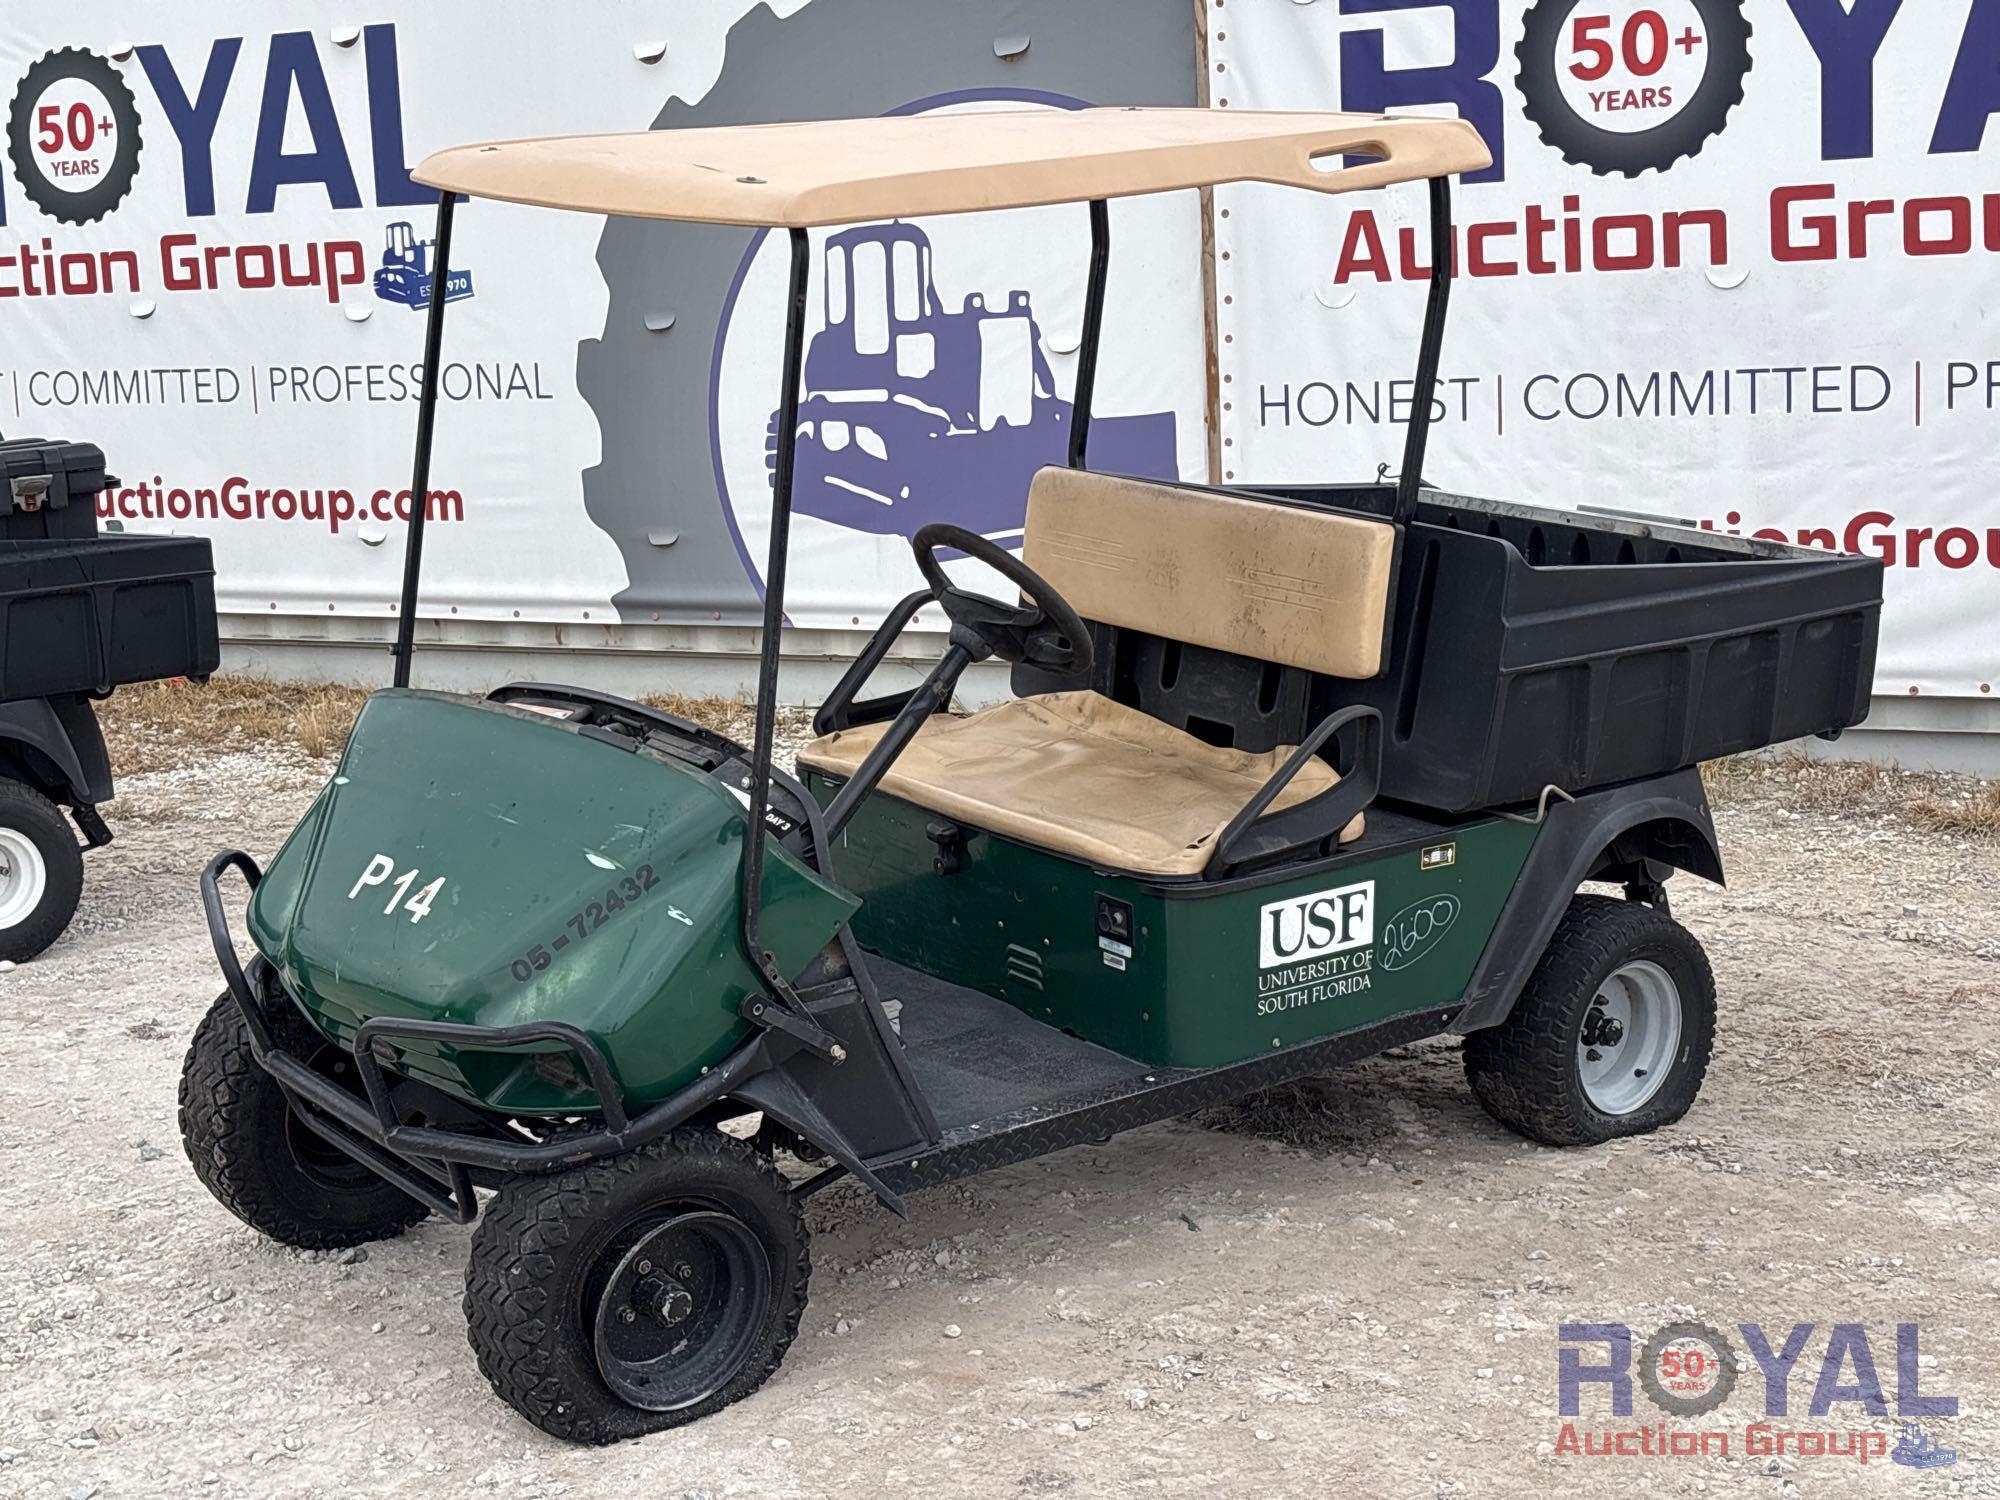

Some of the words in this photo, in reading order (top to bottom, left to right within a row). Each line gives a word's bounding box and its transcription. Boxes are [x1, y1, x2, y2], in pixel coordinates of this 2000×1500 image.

[1568, 9, 1703, 82] 50+
[0, 23, 470, 227] OYAL
[1588, 86, 1673, 113] YEARS
[37, 102, 114, 154] 50+
[51, 158, 100, 177] YEARS
[160, 234, 365, 303] Group
[1333, 196, 1728, 285] Auction
[420, 284, 433, 297] ES
[446, 278, 468, 292] 970
[29, 368, 240, 406] COMMITTED
[269, 362, 554, 404] PROFESSONAL
[1524, 364, 1891, 420] COMMITTED
[765, 813, 785, 826] DAY
[781, 822, 791, 831] 3
[348, 853, 447, 924] P14
[511, 863, 661, 984] 05-72432
[1270, 888, 1368, 957] USF
[1383, 899, 1453, 969] 2600
[1257, 987, 1310, 1016] SOUTH
[1312, 973, 1372, 1004] FLORIDA
[1258, 955, 1349, 991] UNIVERSITY
[1351, 949, 1374, 968] OF
